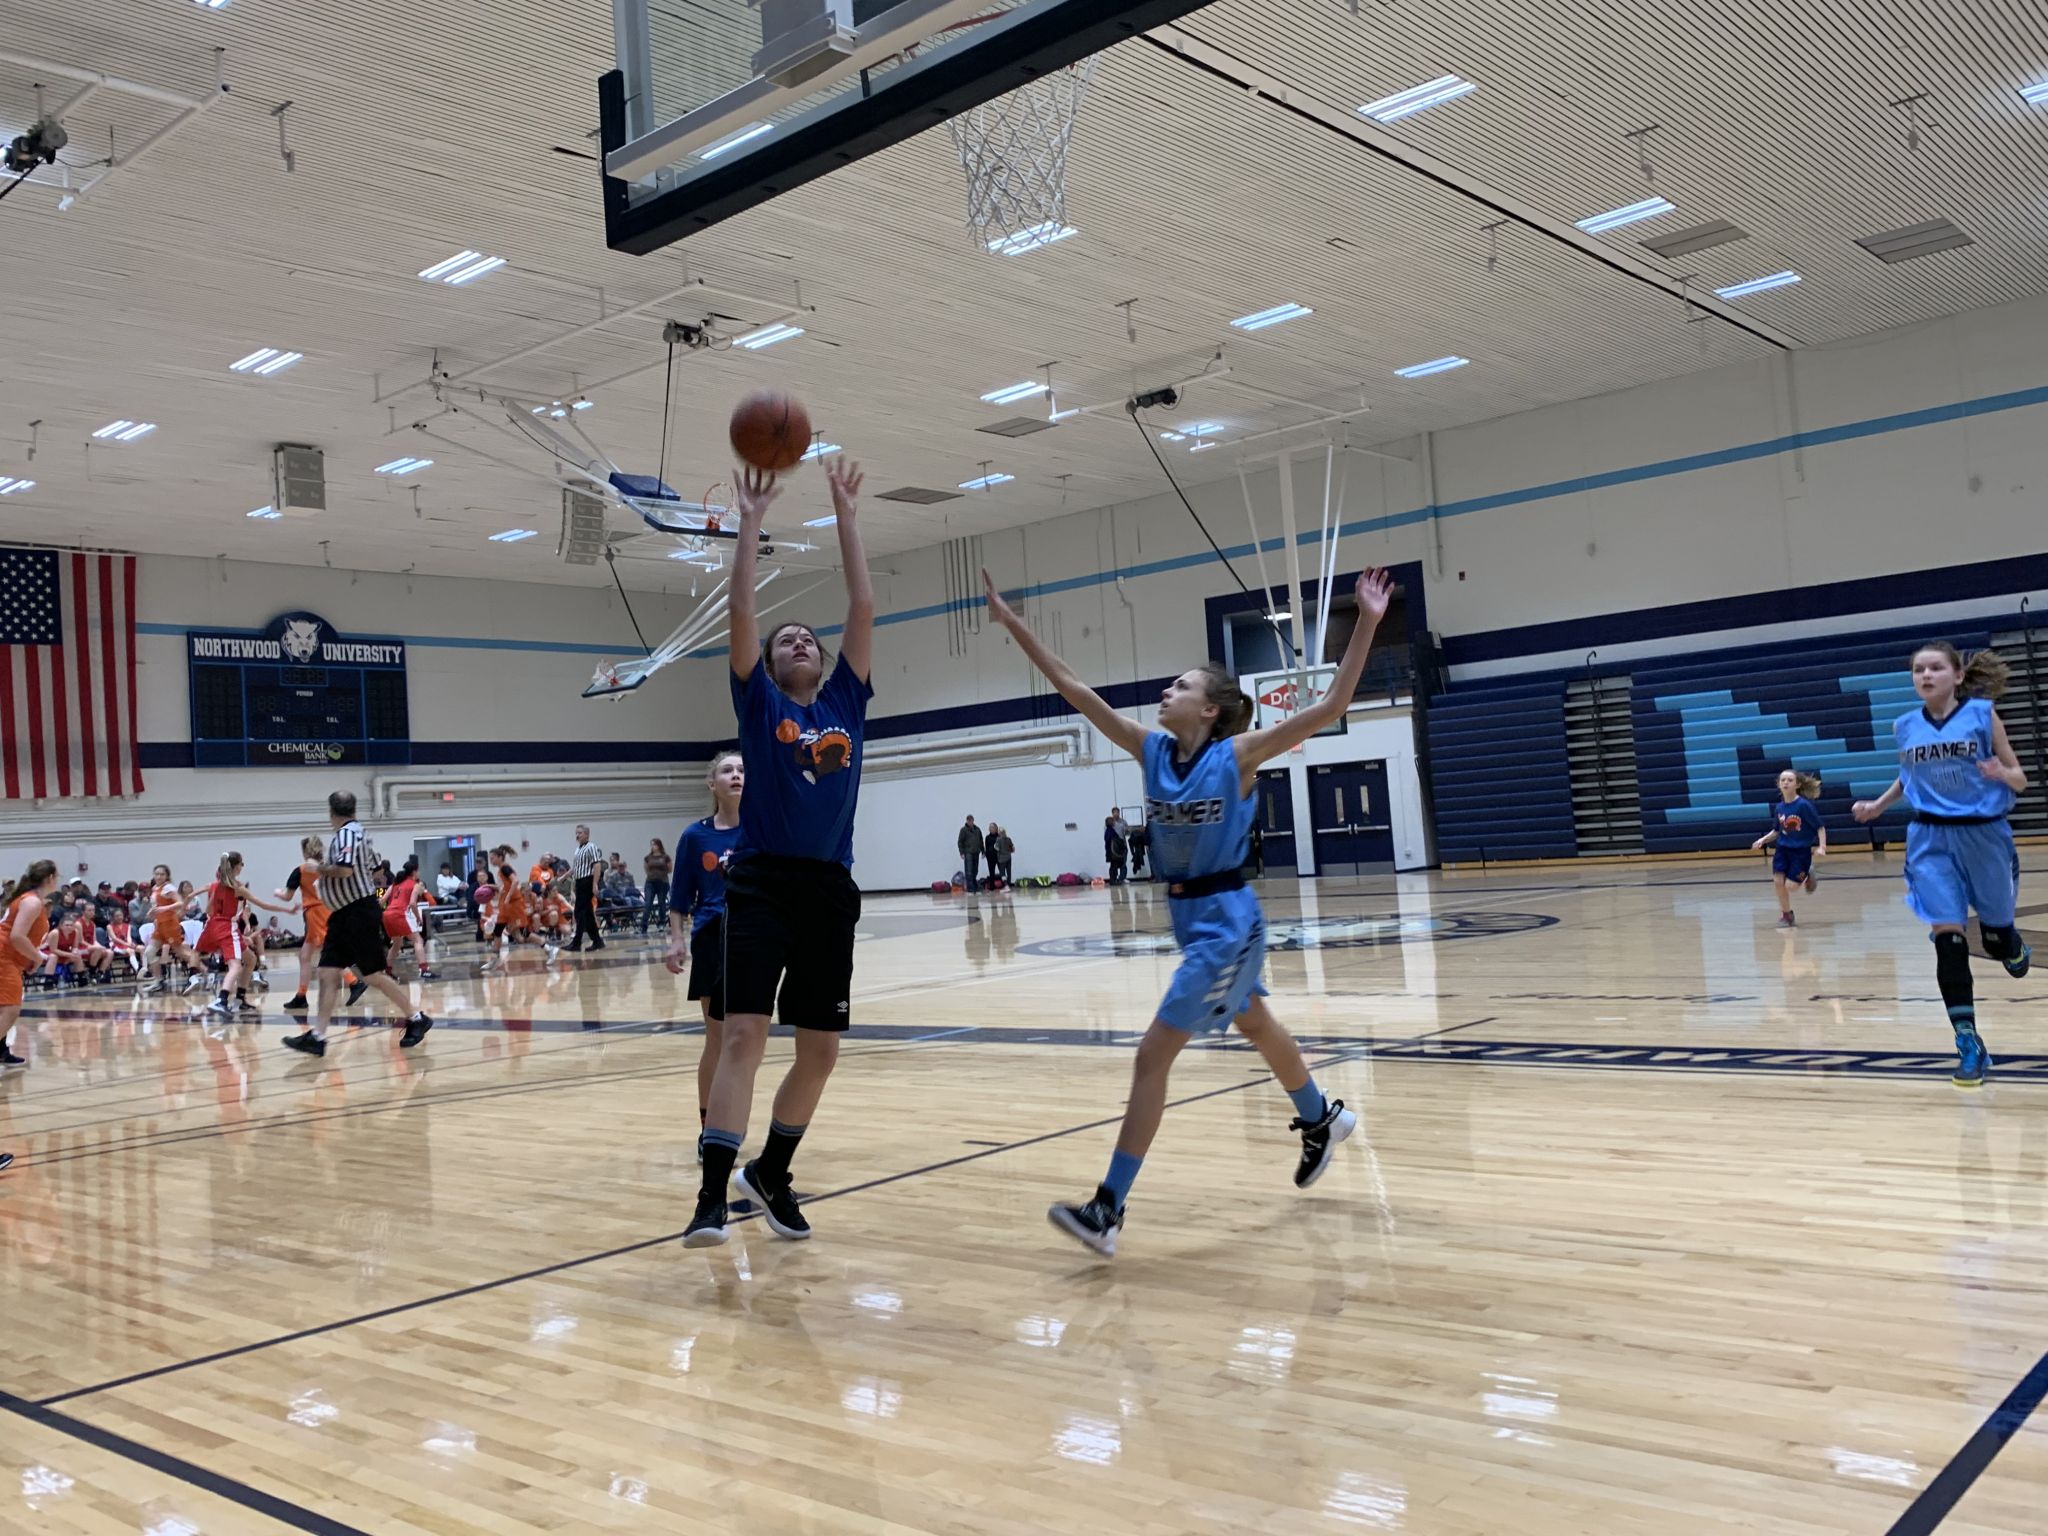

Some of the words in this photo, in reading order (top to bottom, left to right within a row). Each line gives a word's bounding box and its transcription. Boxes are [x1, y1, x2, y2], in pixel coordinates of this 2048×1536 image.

[193, 637, 281, 659] NORTHWOOD
[322, 643, 402, 664] UNIVERSITY
[268, 743, 325, 753] CHEMICAL
[304, 752, 327, 760] BANK
